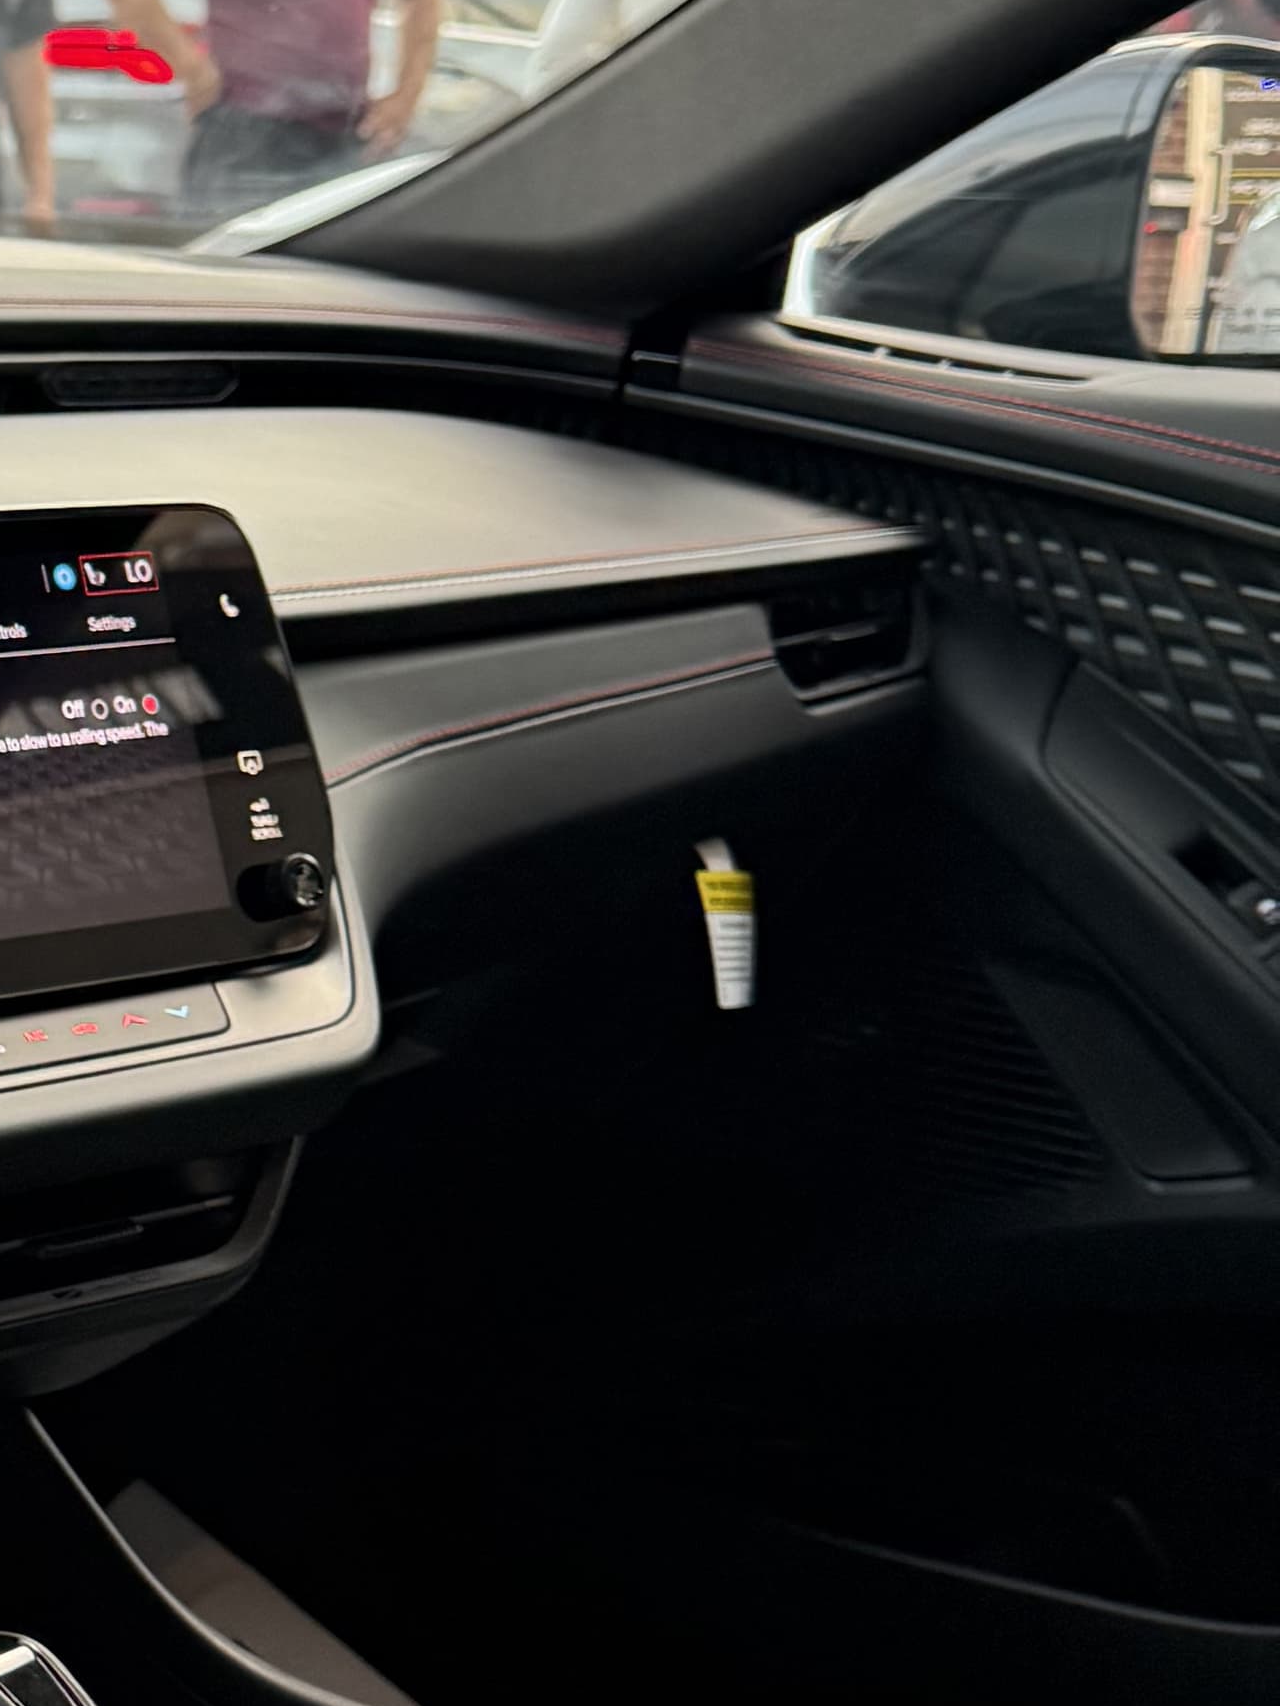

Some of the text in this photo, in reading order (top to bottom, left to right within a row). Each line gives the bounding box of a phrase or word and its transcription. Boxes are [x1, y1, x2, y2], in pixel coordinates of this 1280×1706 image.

[123, 559, 153, 583] LO
[87, 615, 137, 632] Settings
[61, 695, 137, 720] Off On
[5, 736, 20, 753] to
[20, 733, 48, 752] slow
[47, 731, 62, 748] to
[69, 727, 107, 746] rolling
[143, 720, 169, 737] The
